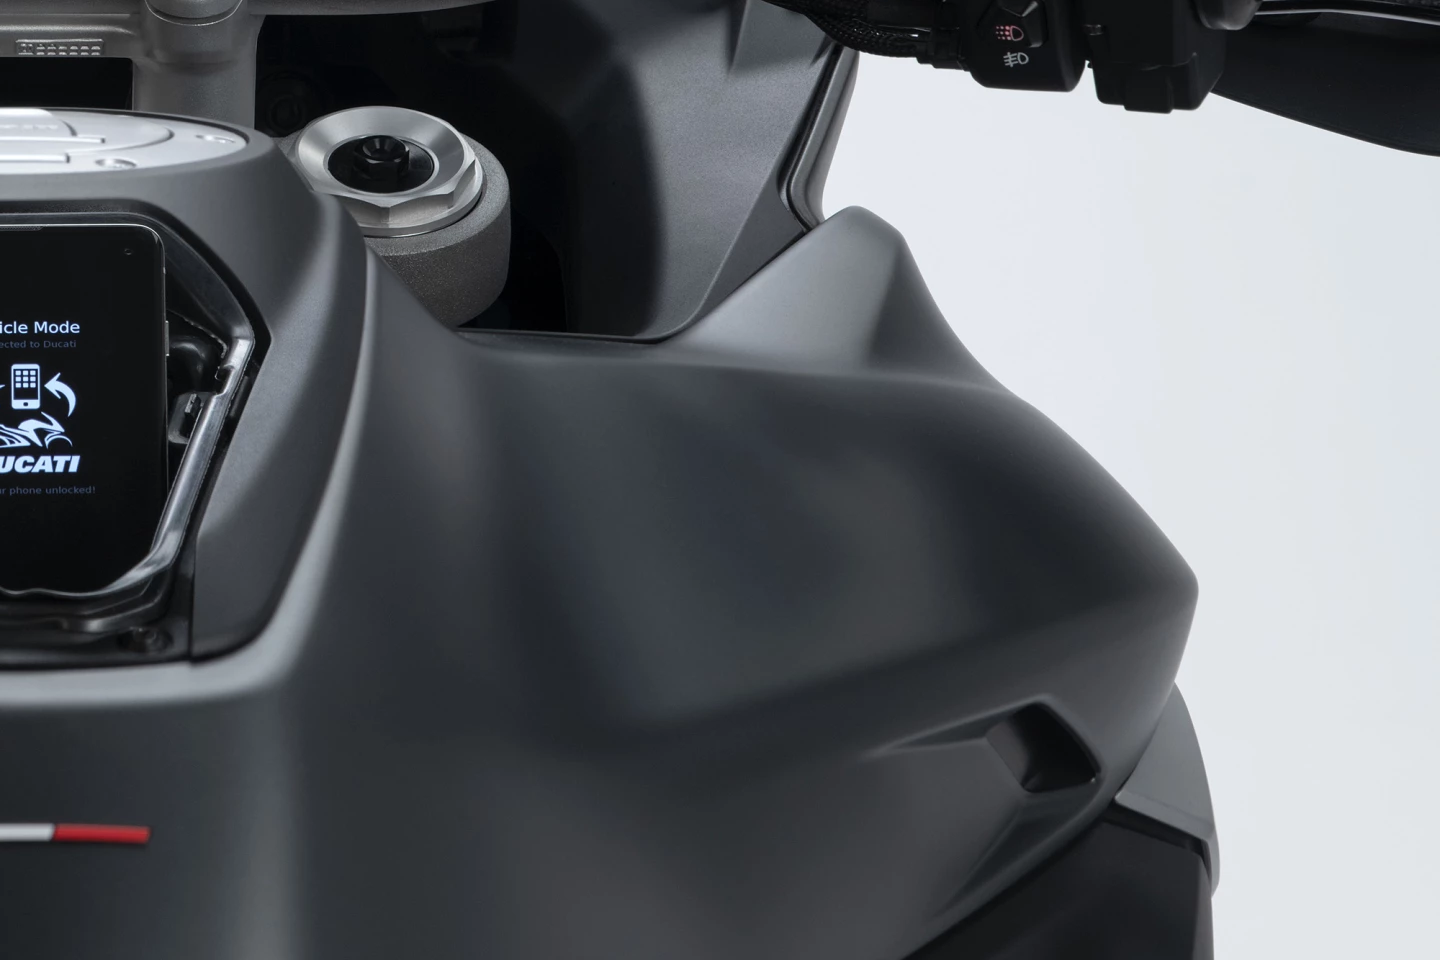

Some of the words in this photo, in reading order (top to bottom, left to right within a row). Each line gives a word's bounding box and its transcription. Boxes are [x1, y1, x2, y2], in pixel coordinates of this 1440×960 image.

[34, 321, 80, 334] Mode
[30, 341, 40, 349] to
[43, 340, 76, 349] Ducati
[9, 486, 42, 496] phone
[45, 485, 96, 495] unlocked!
